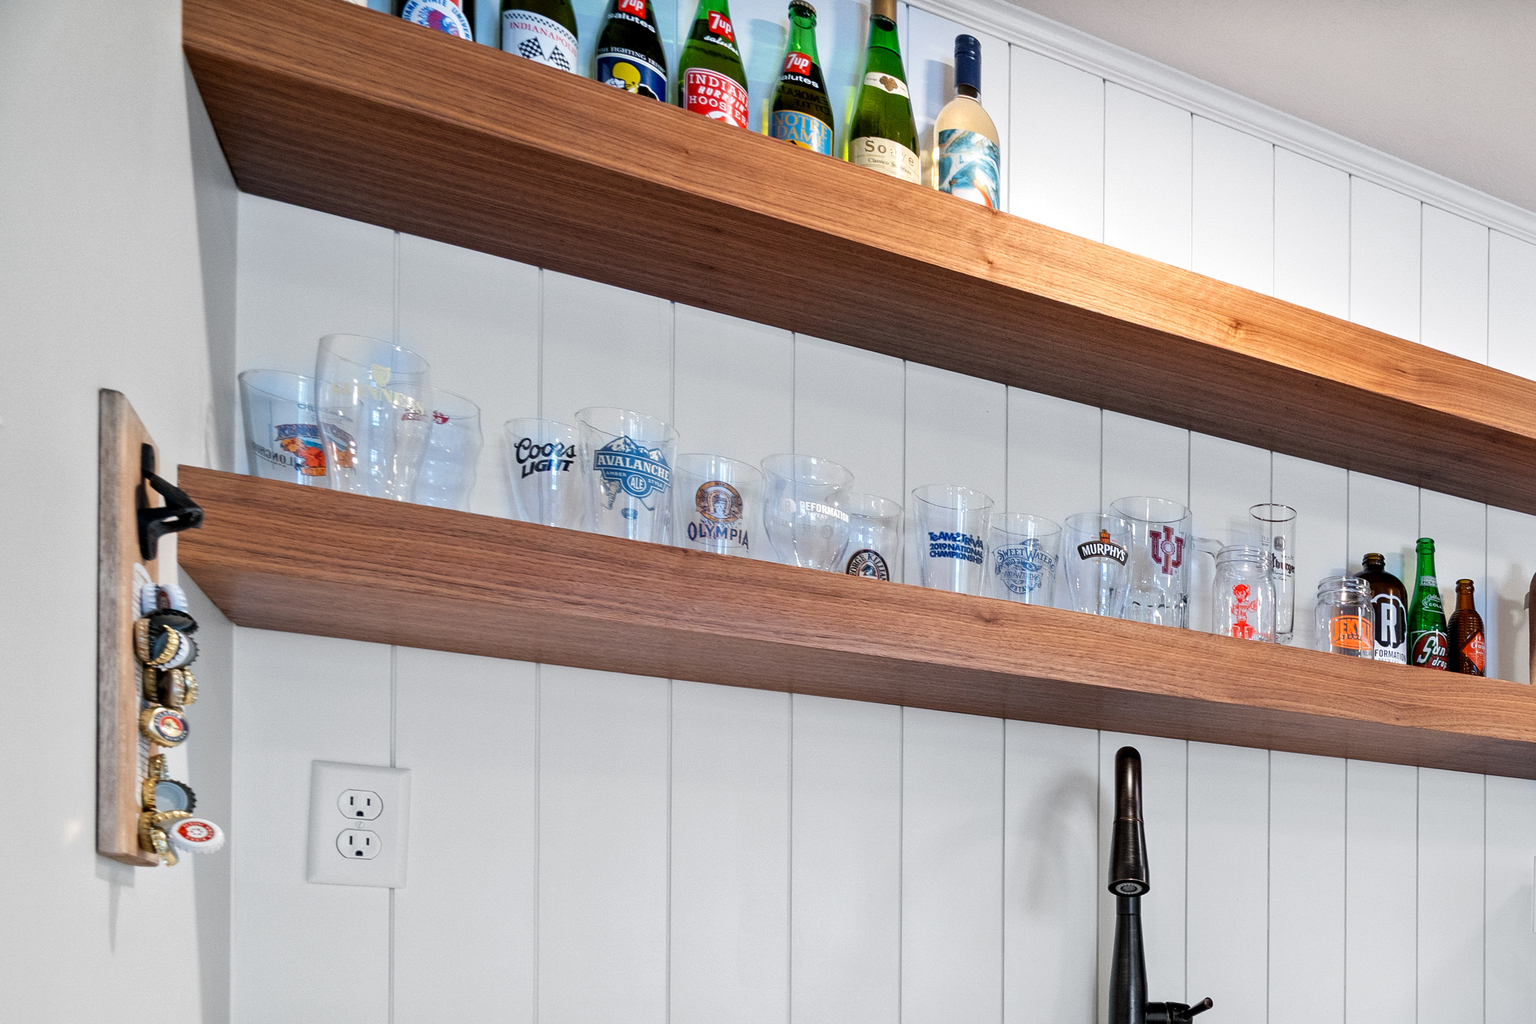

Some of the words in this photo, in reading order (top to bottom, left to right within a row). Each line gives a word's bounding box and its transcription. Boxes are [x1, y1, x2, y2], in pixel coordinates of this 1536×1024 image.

[607, 12, 656, 33] salutes
[711, 13, 732, 33] 7up
[788, 53, 809, 69] 7up
[775, 114, 828, 138] NOTRE
[777, 125, 825, 150] DAME
[864, 140, 914, 167] Soave
[514, 437, 576, 464] Coors
[522, 459, 574, 479] LIGHT
[598, 455, 670, 481] AVALANCHE
[631, 477, 644, 490] ALE
[647, 478, 664, 488] STYLE
[688, 521, 749, 550] OLYMPIA
[930, 543, 947, 551] 2019
[948, 544, 983, 559] NATIONAL
[1381, 603, 1398, 647] R
